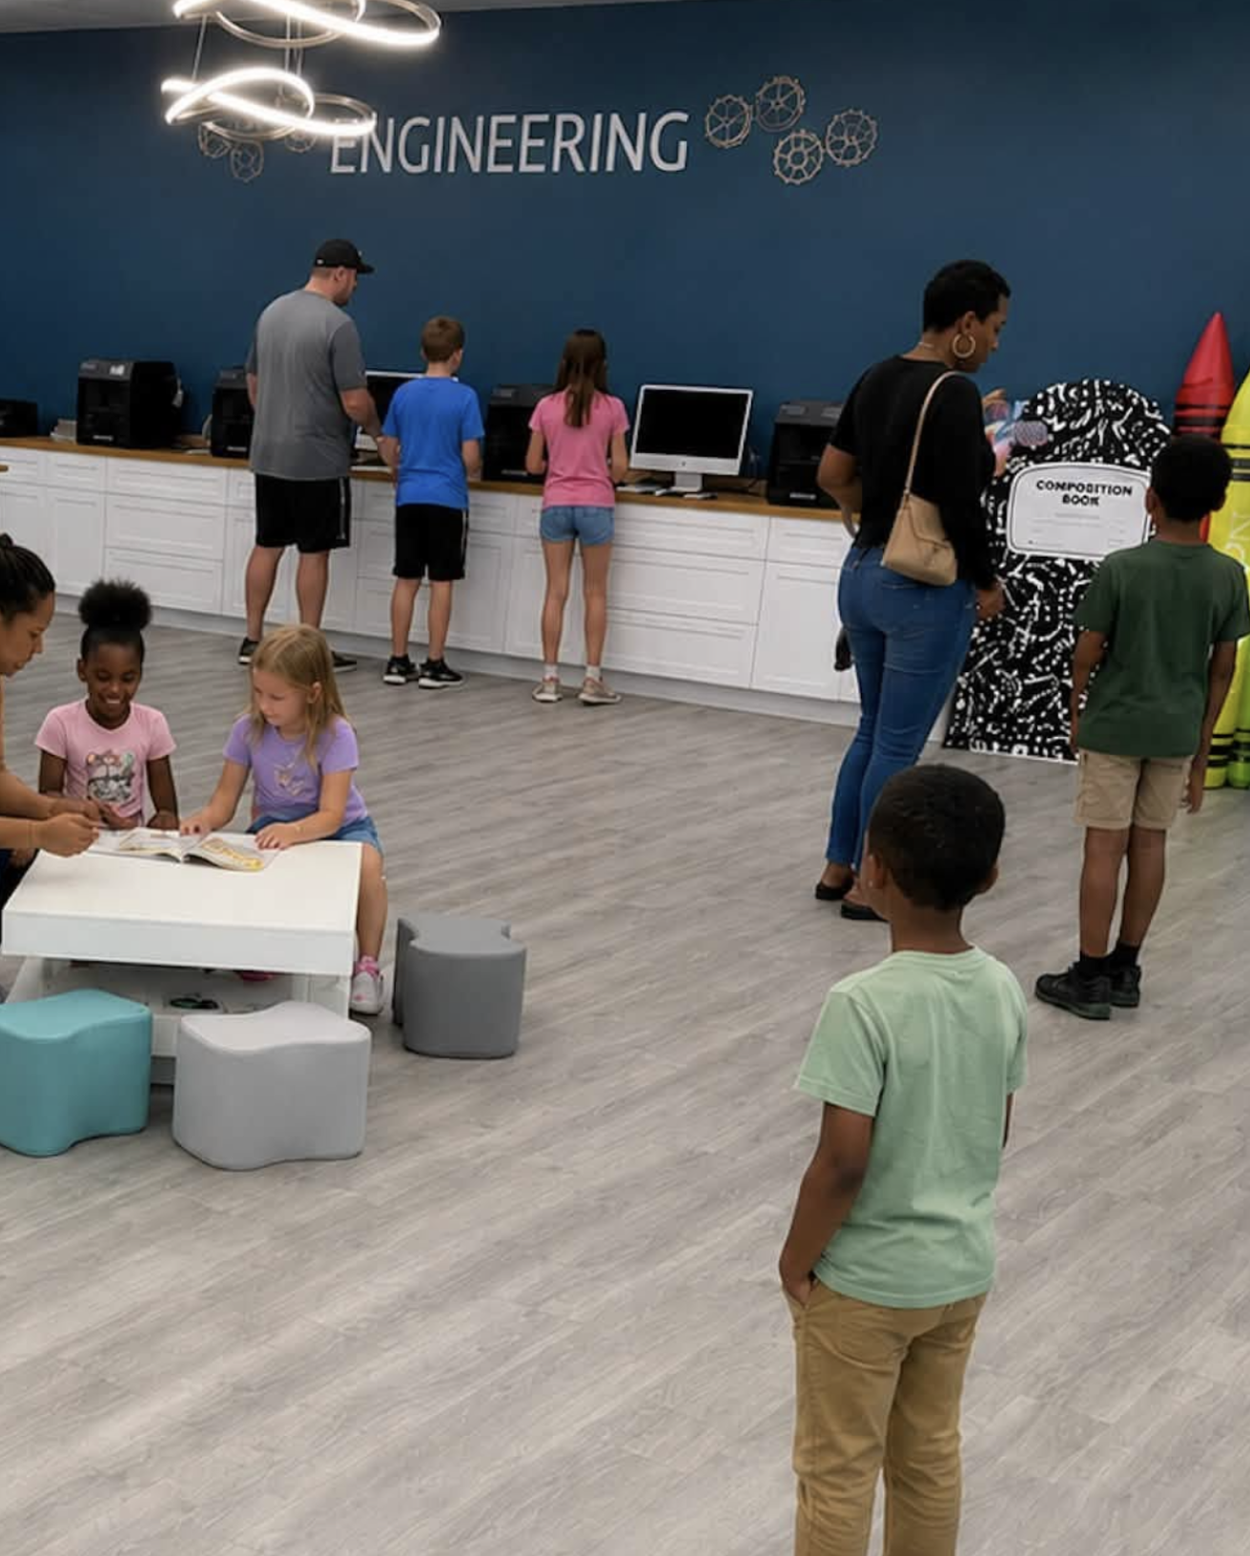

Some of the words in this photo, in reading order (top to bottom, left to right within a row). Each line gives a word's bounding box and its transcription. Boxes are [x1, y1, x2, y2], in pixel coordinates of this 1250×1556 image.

[330, 111, 690, 174] ENGINEERING
[1036, 480, 1132, 496] COMPOSITION
[1062, 493, 1100, 506] BOOK
